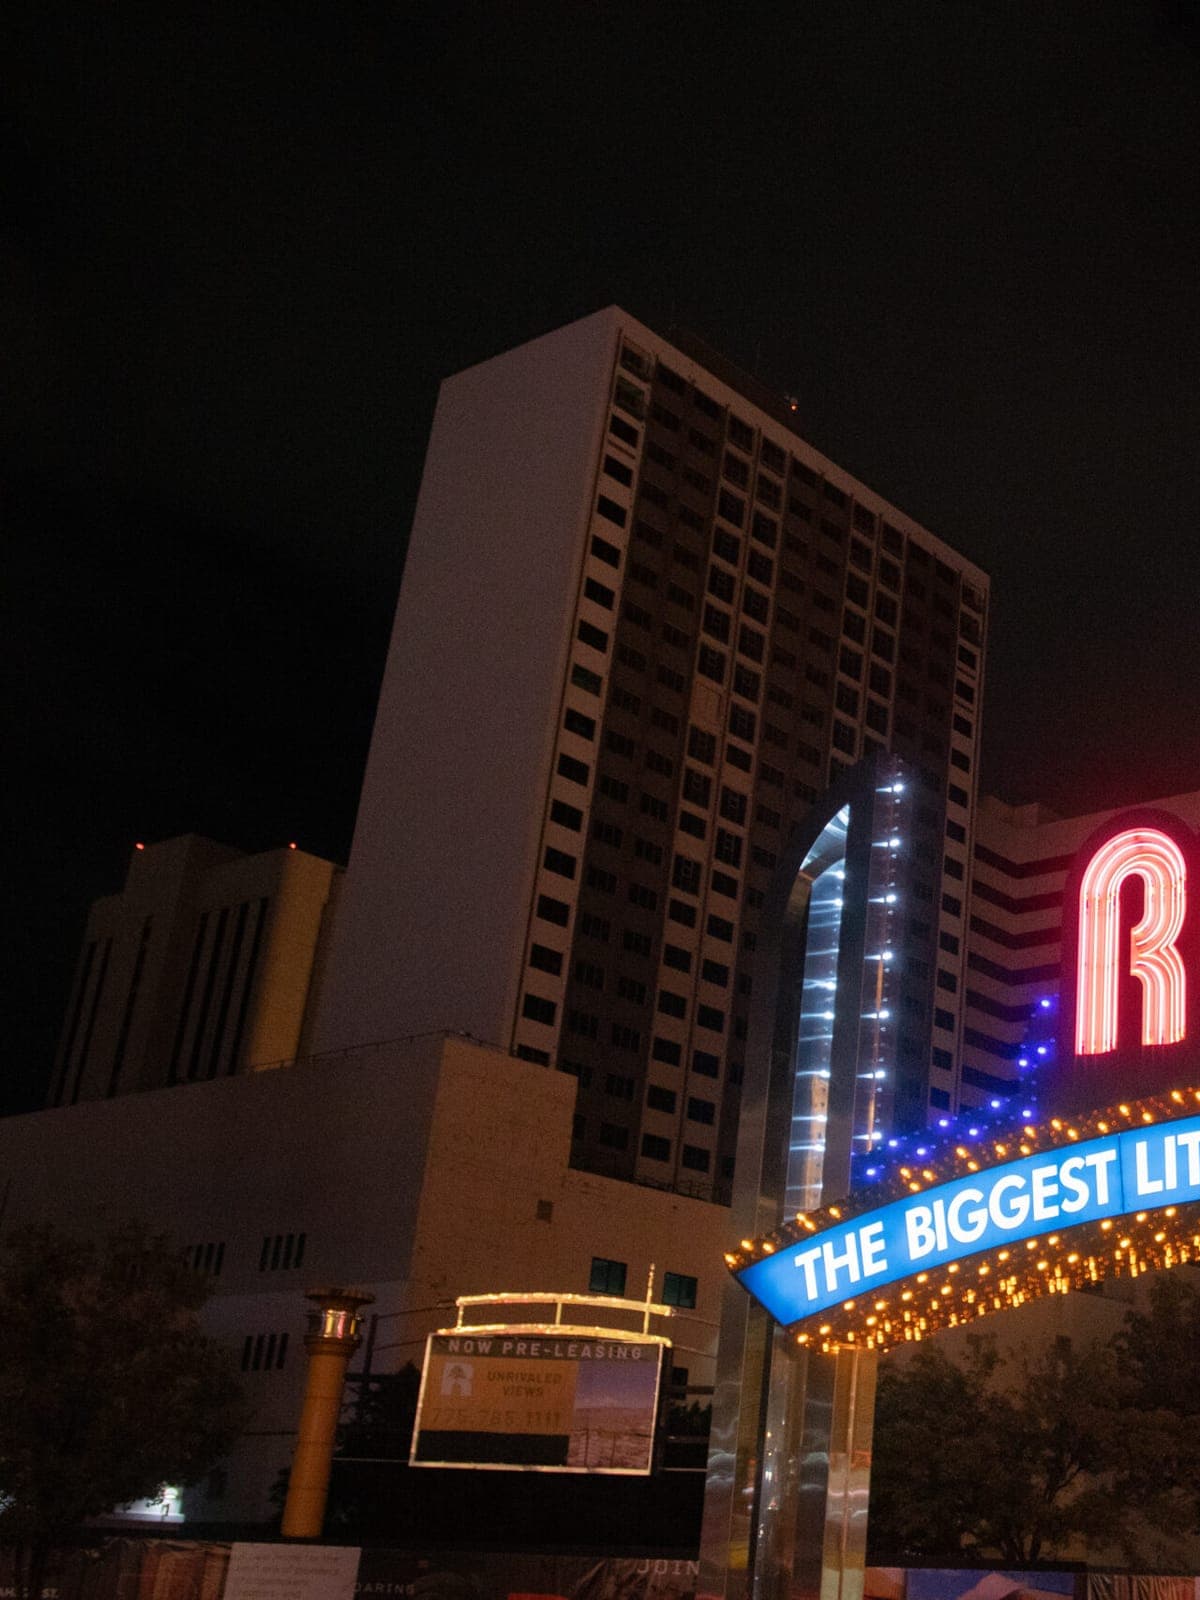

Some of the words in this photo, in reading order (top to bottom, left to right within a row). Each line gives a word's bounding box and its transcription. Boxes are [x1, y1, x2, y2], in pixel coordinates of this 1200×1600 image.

[795, 1221, 888, 1301] THE
[905, 1148, 1118, 1261] BIGGEST
[450, 1340, 491, 1355] NOW
[502, 1341, 643, 1360] PRE-LEASING
[487, 1370, 563, 1385] UNRIVALED
[503, 1385, 545, 1397] VIEWS
[637, 1558, 700, 1576] JOIN
